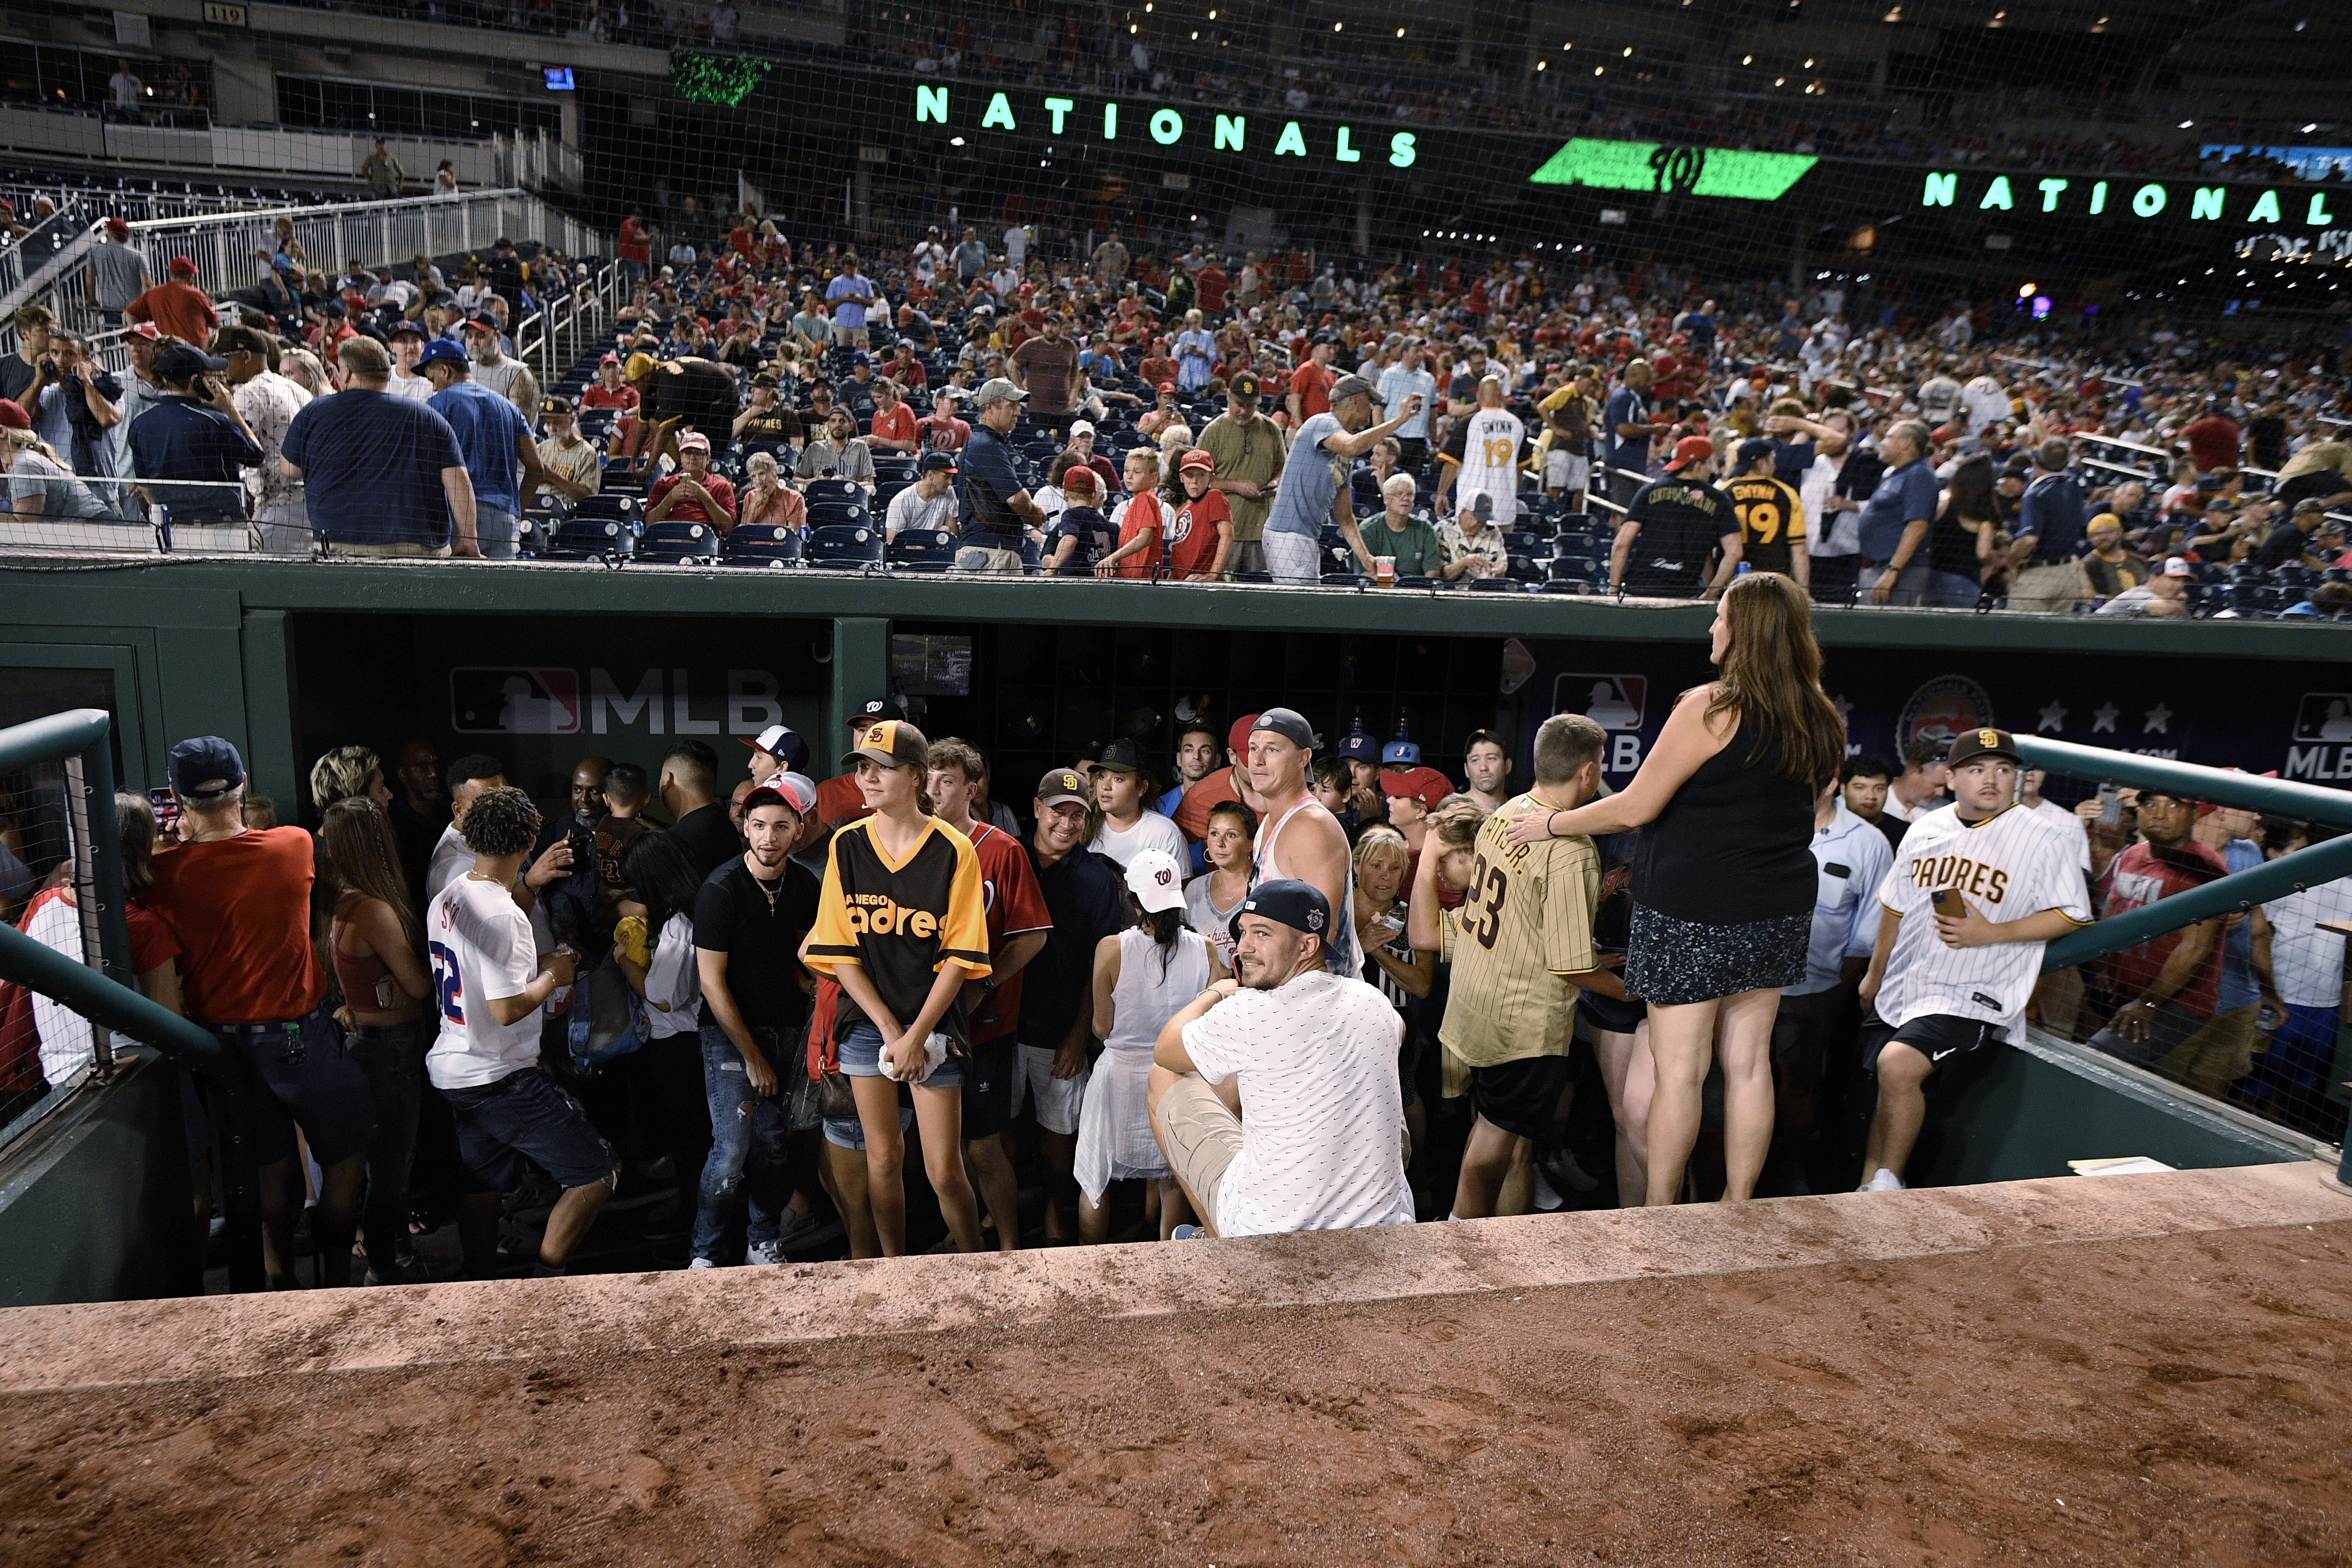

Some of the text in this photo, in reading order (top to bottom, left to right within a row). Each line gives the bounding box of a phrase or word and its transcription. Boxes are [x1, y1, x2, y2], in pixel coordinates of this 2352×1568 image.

[916, 85, 1416, 167] NATIONALS
[1922, 172, 2334, 226] NATIONAL
[1243, 381, 1253, 394] SD
[1481, 422, 1512, 434] GWYNN
[1483, 439, 1512, 467] 19
[1732, 484, 1777, 501] GWYNN
[1734, 502, 1781, 545] 19
[590, 667, 783, 735] MLB
[865, 700, 884, 713] W
[869, 727, 884, 742] SD
[1350, 737, 1363, 749] W
[1978, 729, 1999, 749] SD
[1063, 774, 1078, 791] SD
[1154, 867, 1172, 886] W
[1911, 855, 2008, 904] PADRES
[1461, 852, 1507, 950] 23
